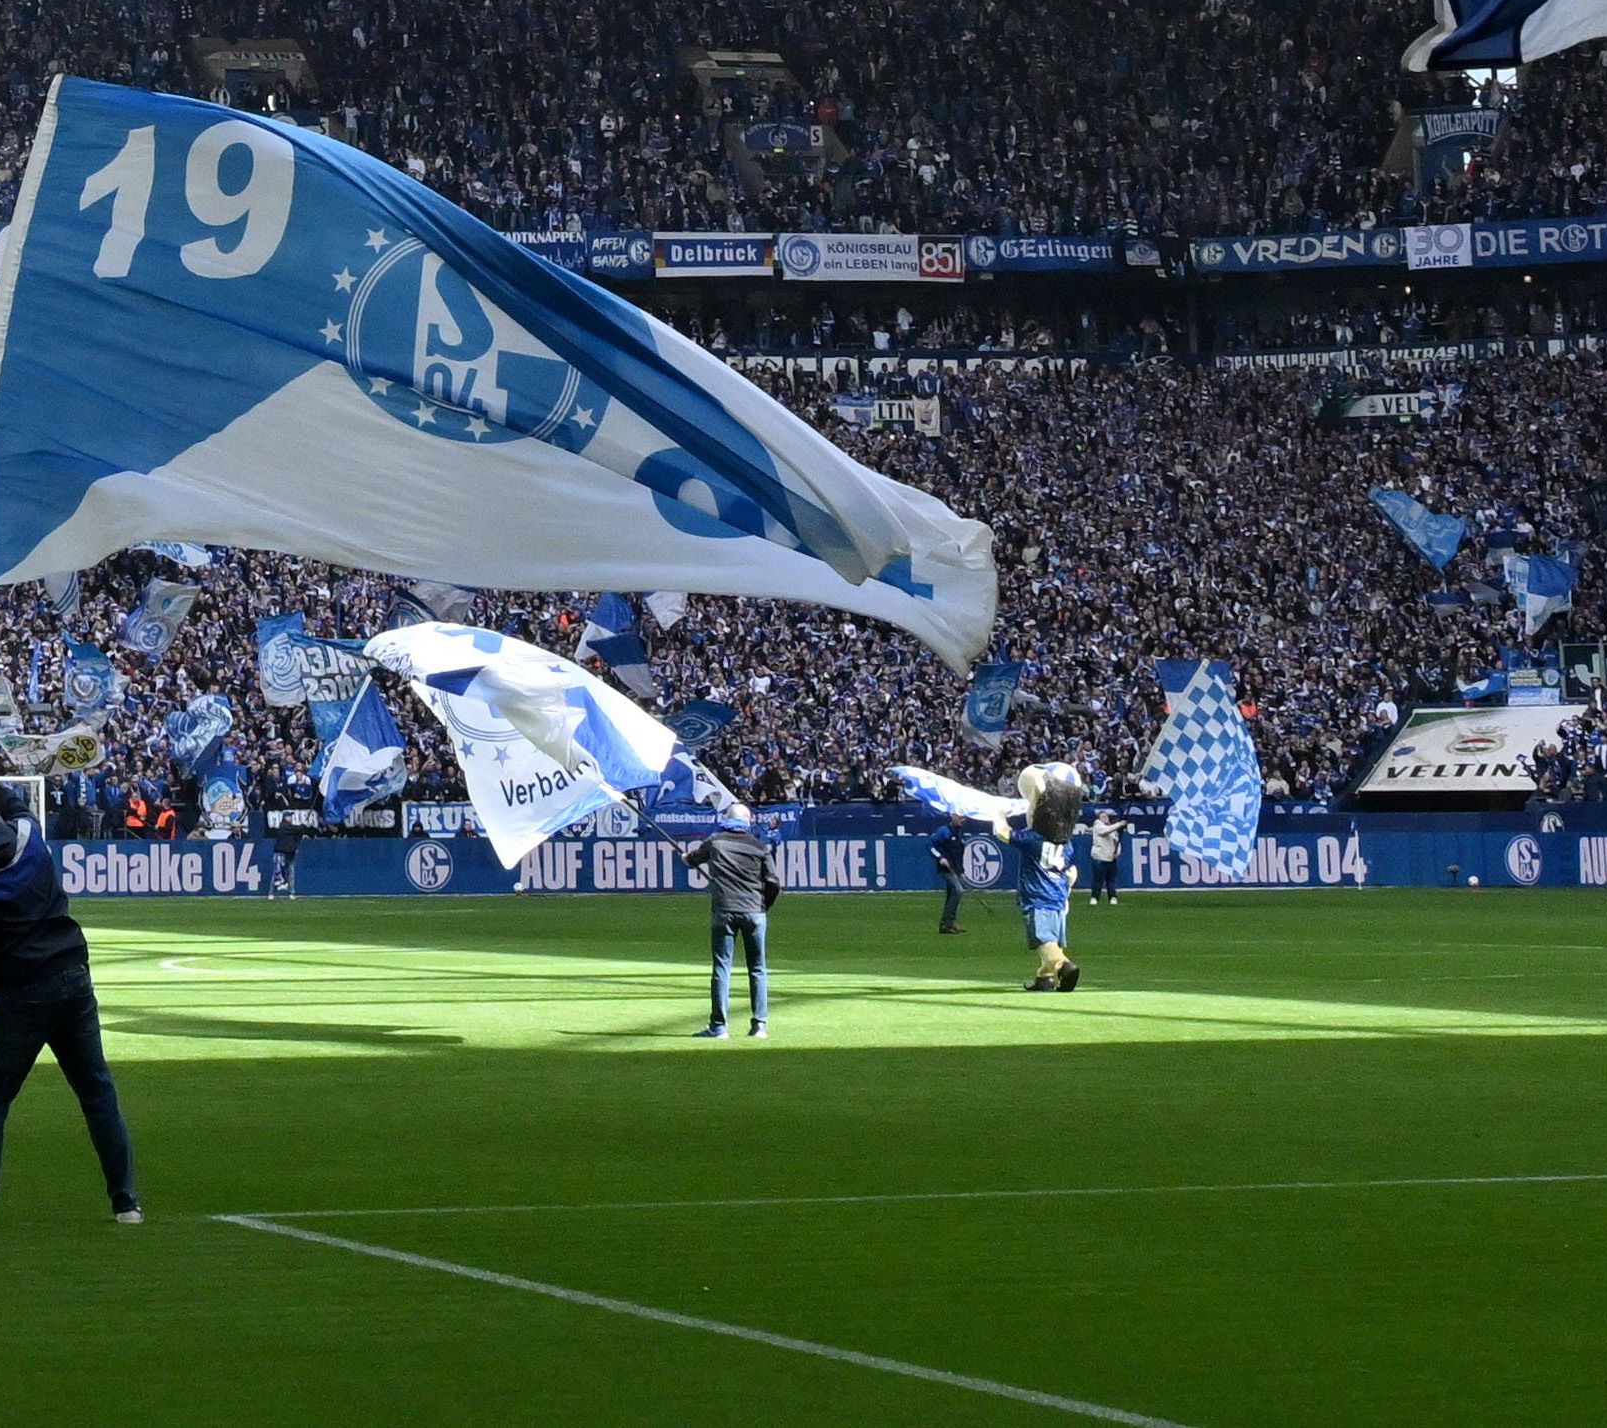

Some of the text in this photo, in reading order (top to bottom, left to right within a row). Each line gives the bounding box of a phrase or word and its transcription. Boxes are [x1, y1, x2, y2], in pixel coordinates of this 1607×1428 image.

[79, 119, 296, 281] 19
[670, 242, 758, 263] Delbrück
[826, 241, 912, 255] KÖNIGSBLAU
[1233, 232, 1365, 264] VREDEN
[1412, 225, 1464, 255] 30
[1475, 229, 1529, 257] DIE
[823, 259, 918, 272] ein LEBEN lang
[920, 242, 962, 274] 851
[1415, 255, 1460, 268] JAHRE
[1390, 346, 1459, 361] ULTRAS
[1380, 396, 1420, 415] VELT
[61, 841, 262, 896] Schalke 04
[519, 840, 584, 891] AUF
[1131, 836, 1171, 884] FC
[1317, 835, 1367, 885] 04
